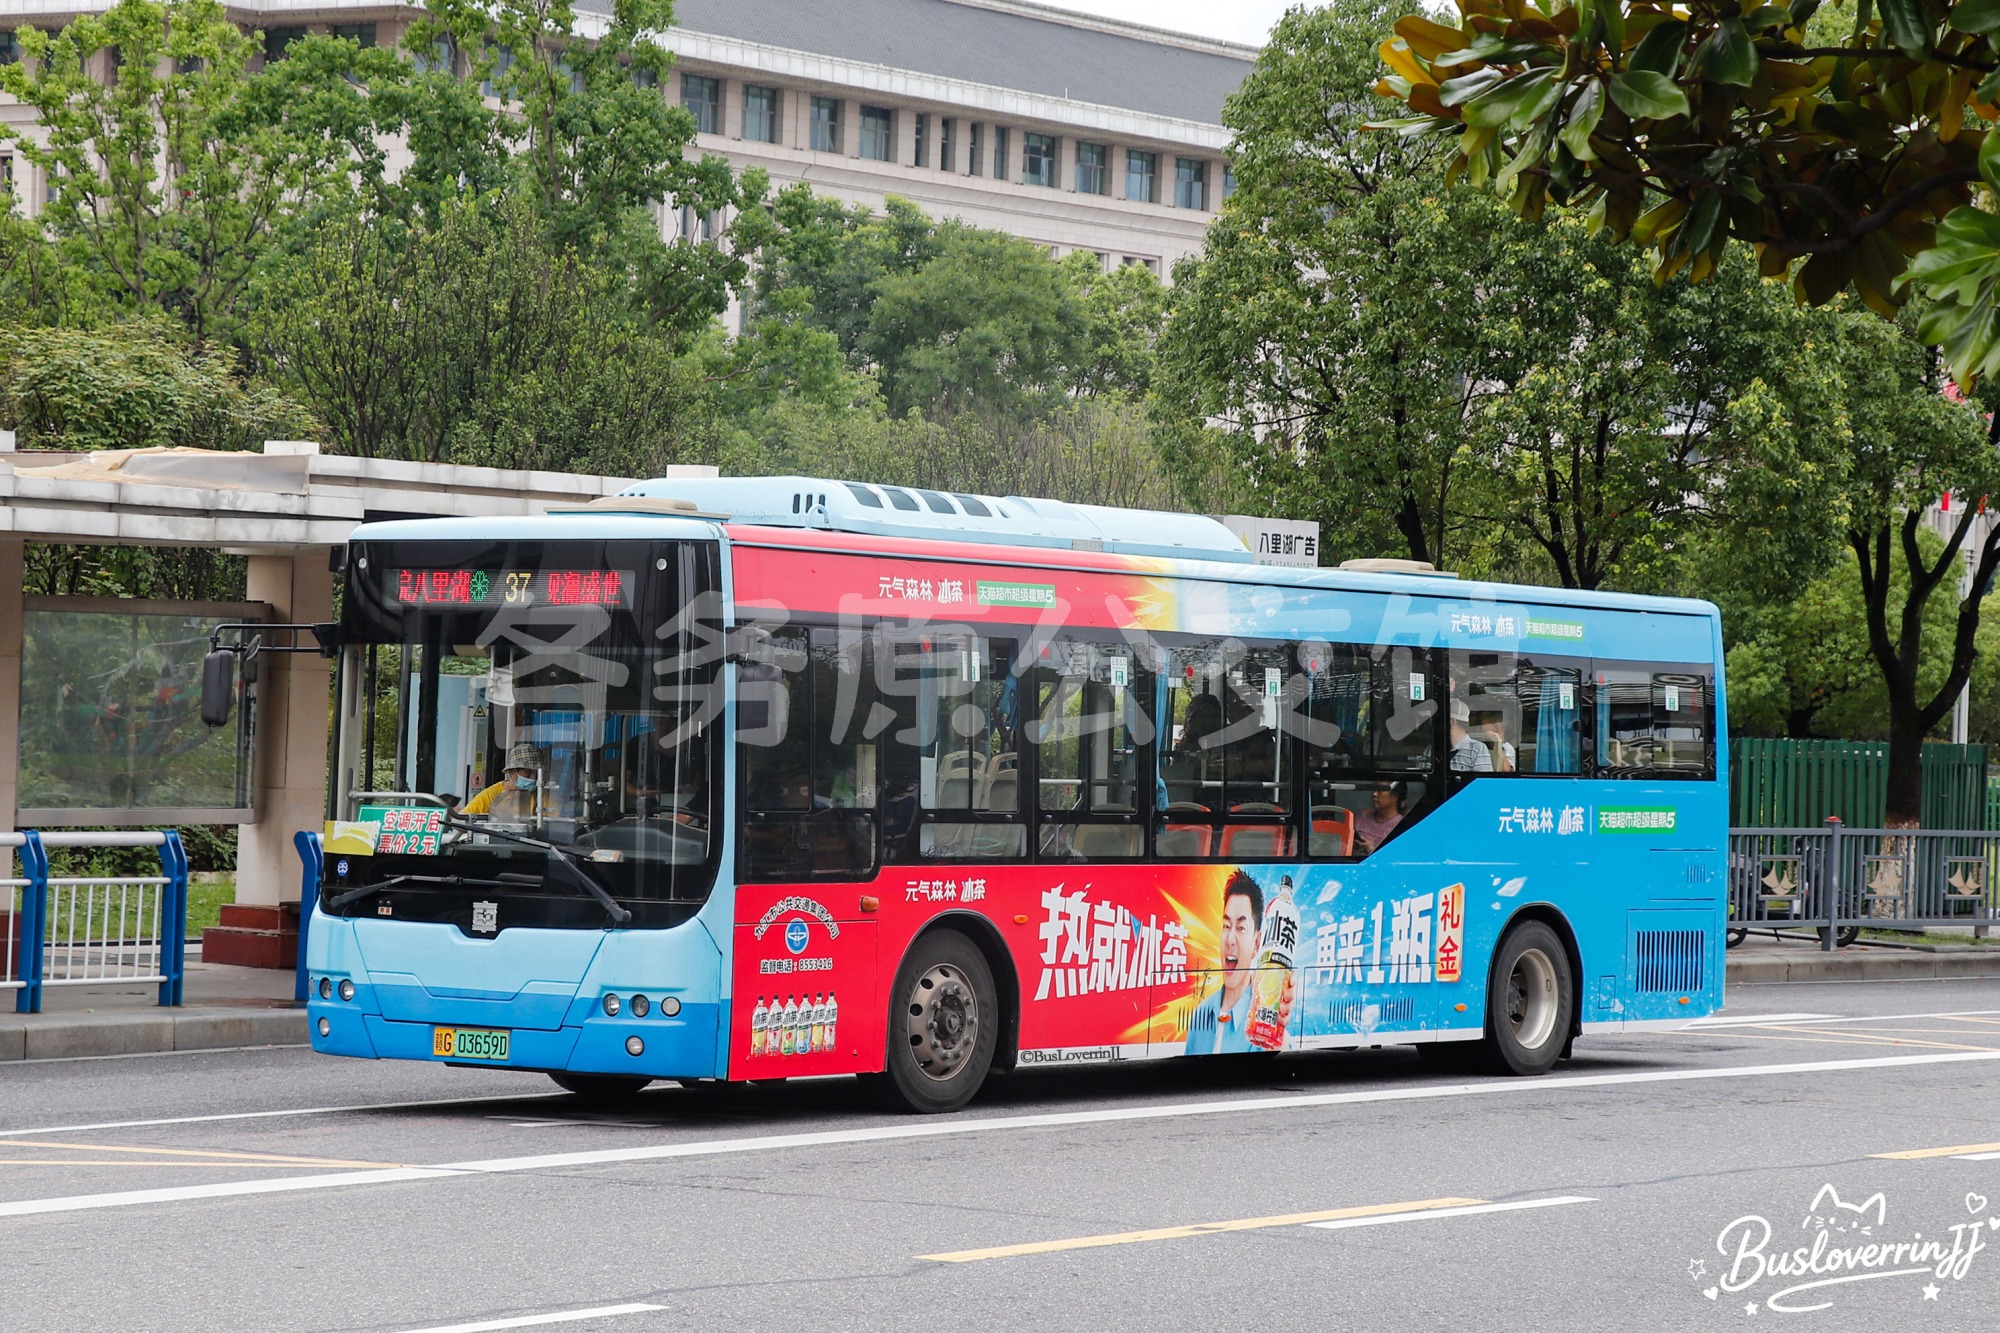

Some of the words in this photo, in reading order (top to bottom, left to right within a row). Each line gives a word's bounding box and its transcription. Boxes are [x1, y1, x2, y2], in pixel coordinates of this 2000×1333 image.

[1259, 533, 1316, 556] 八里湖广告
[505, 572, 532, 603] 37
[879, 576, 934, 601] 元气森林
[937, 578, 963, 604] 冰茶
[978, 585, 1054, 604] 天猫超市超级星期5
[1451, 614, 1493, 635] 元气森林
[1495, 615, 1515, 637] 冰茶
[382, 810, 443, 832] 空调开启
[1498, 806, 1554, 834] 元气森林
[1557, 805, 1585, 836] 冰茶
[1599, 811, 1676, 829] 天猫超市超级星期5
[378, 833, 436, 856] 票价2元
[905, 880, 957, 902] 元气森林
[960, 877, 986, 902] 冰茶
[754, 896, 840, 940] 九江市公共交通集团公司
[1033, 881, 1189, 1001] 热就冰茶
[1315, 892, 1435, 985] 再来1瓶
[1438, 890, 1461, 976] 礼金
[458, 1033, 508, 1056] 03659D
